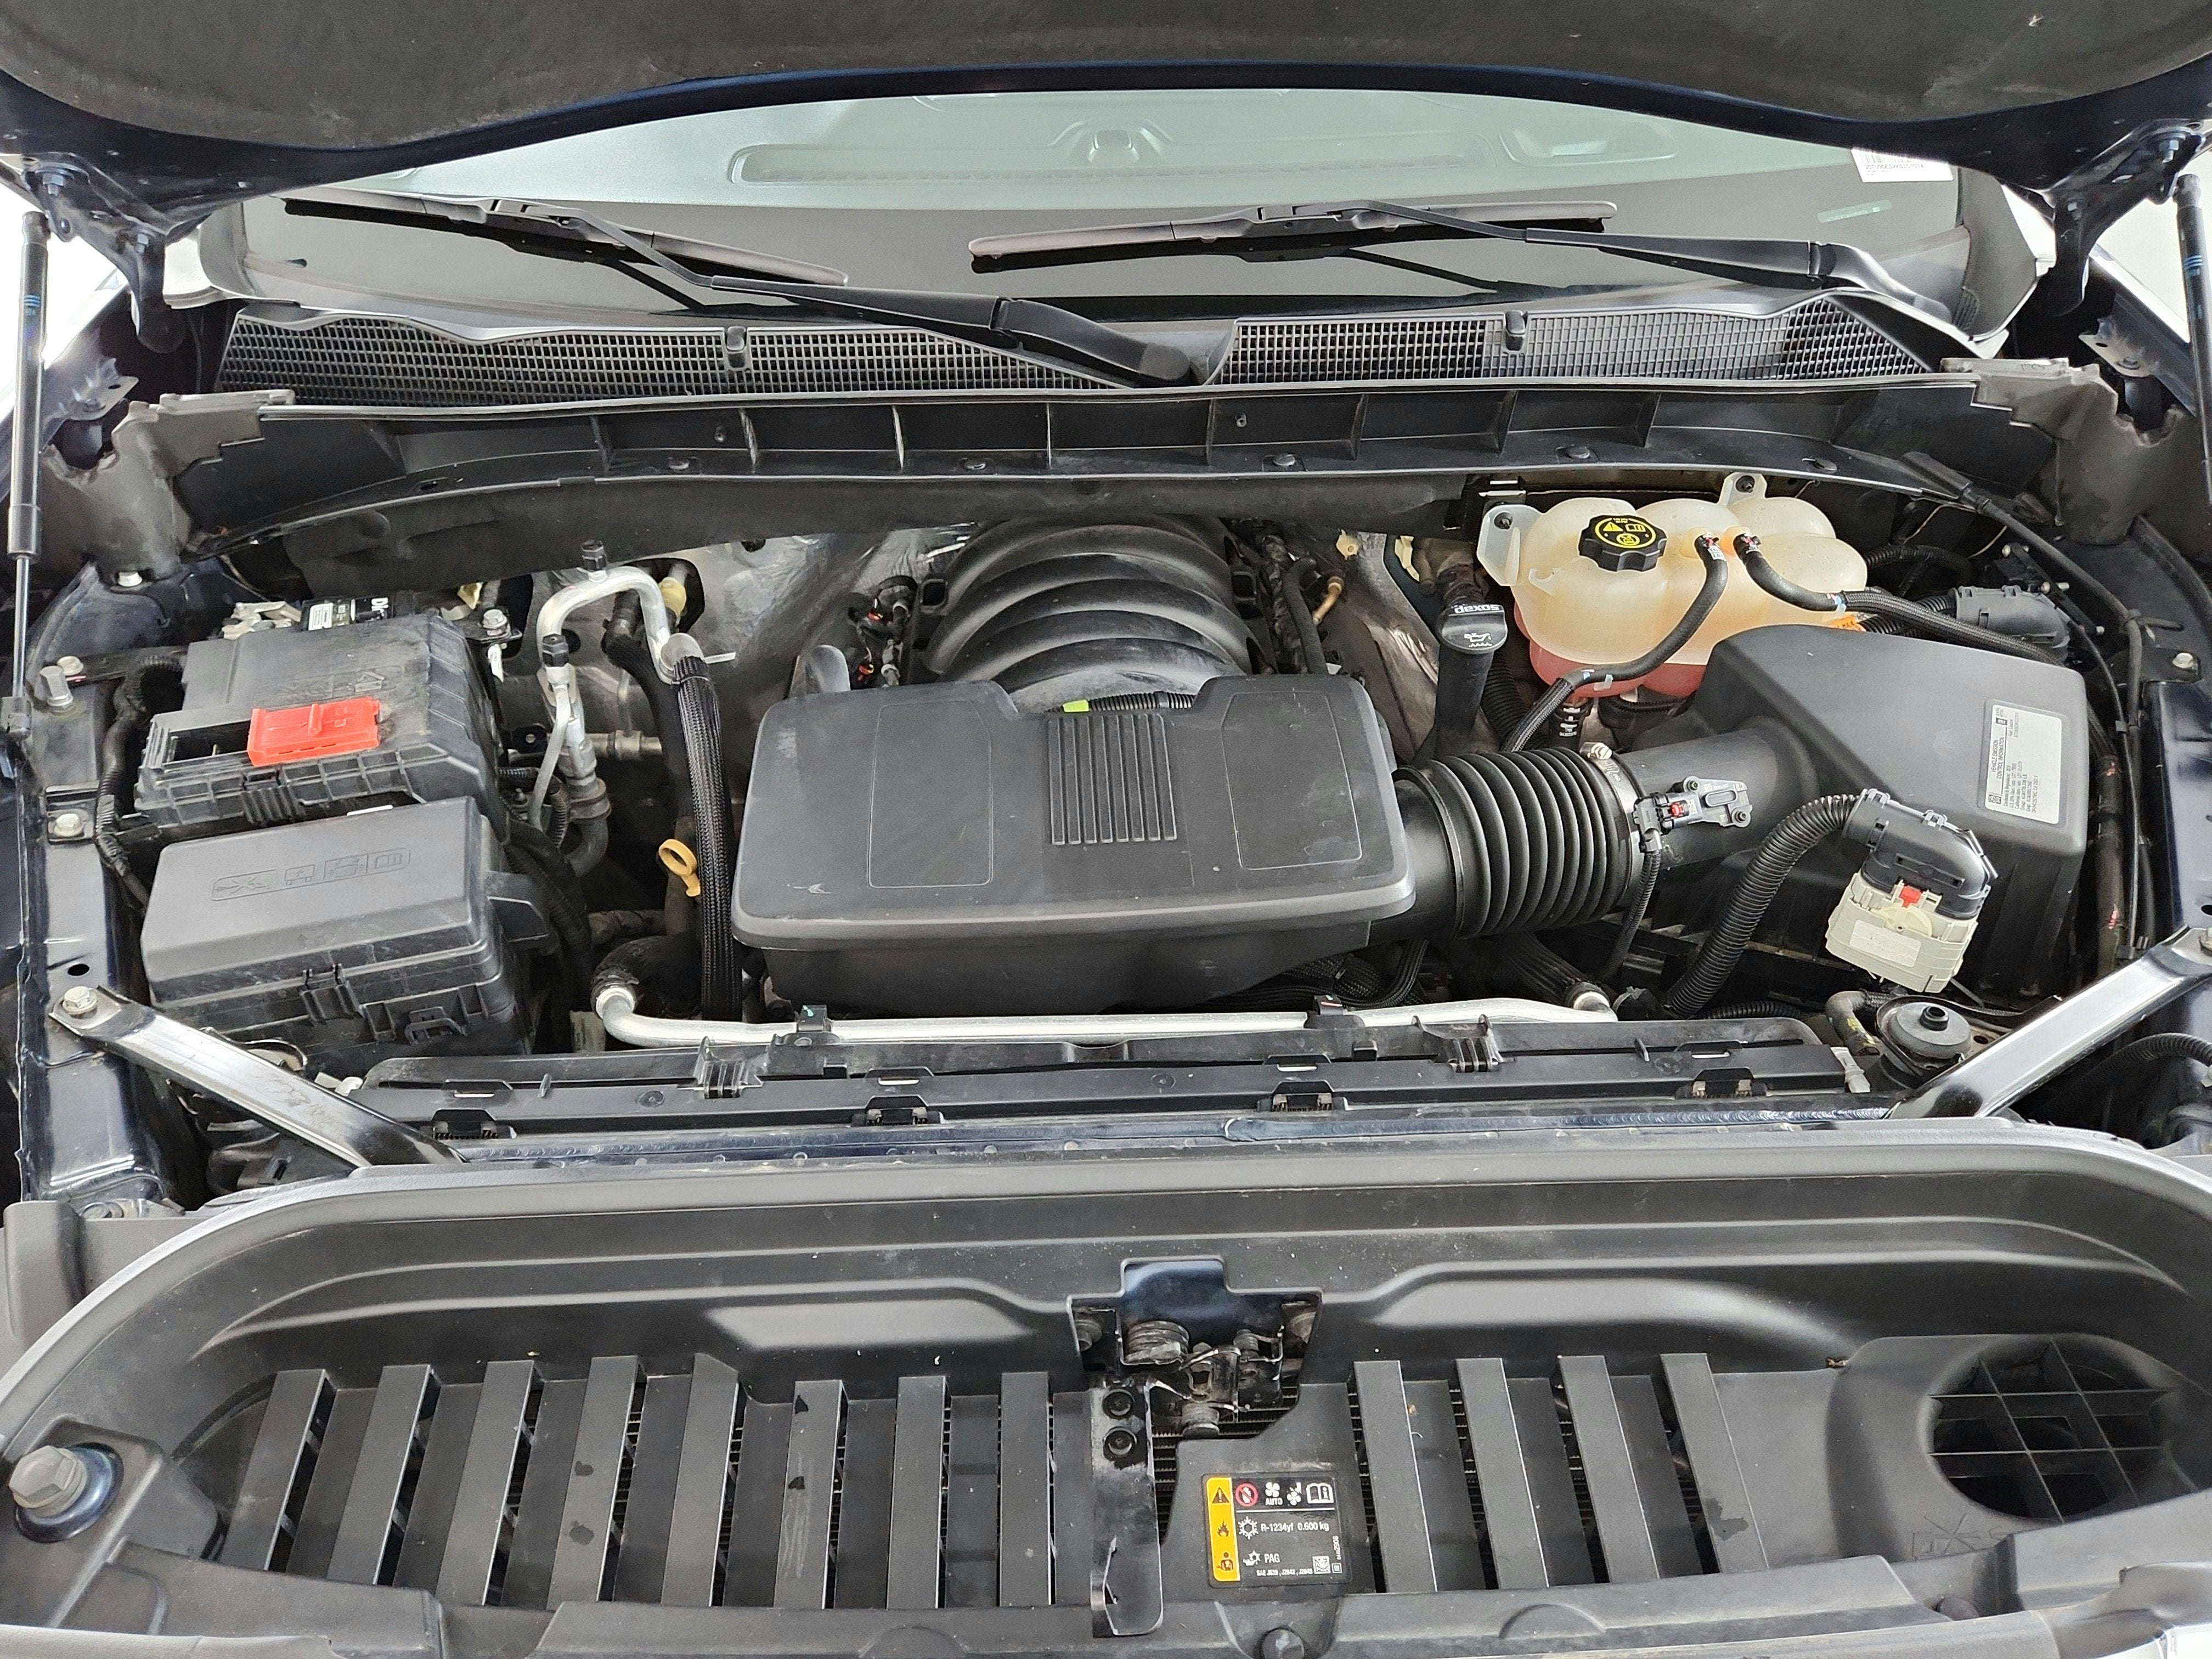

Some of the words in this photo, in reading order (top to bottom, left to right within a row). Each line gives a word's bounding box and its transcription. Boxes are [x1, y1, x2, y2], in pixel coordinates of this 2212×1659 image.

[1454, 605, 1500, 613] dexos
[1261, 1523, 1294, 1533] R-1234yf
[1297, 1522, 1318, 1531] 0.600
[1319, 1521, 1329, 1532] kg
[1264, 1554, 1280, 1563] PAG
